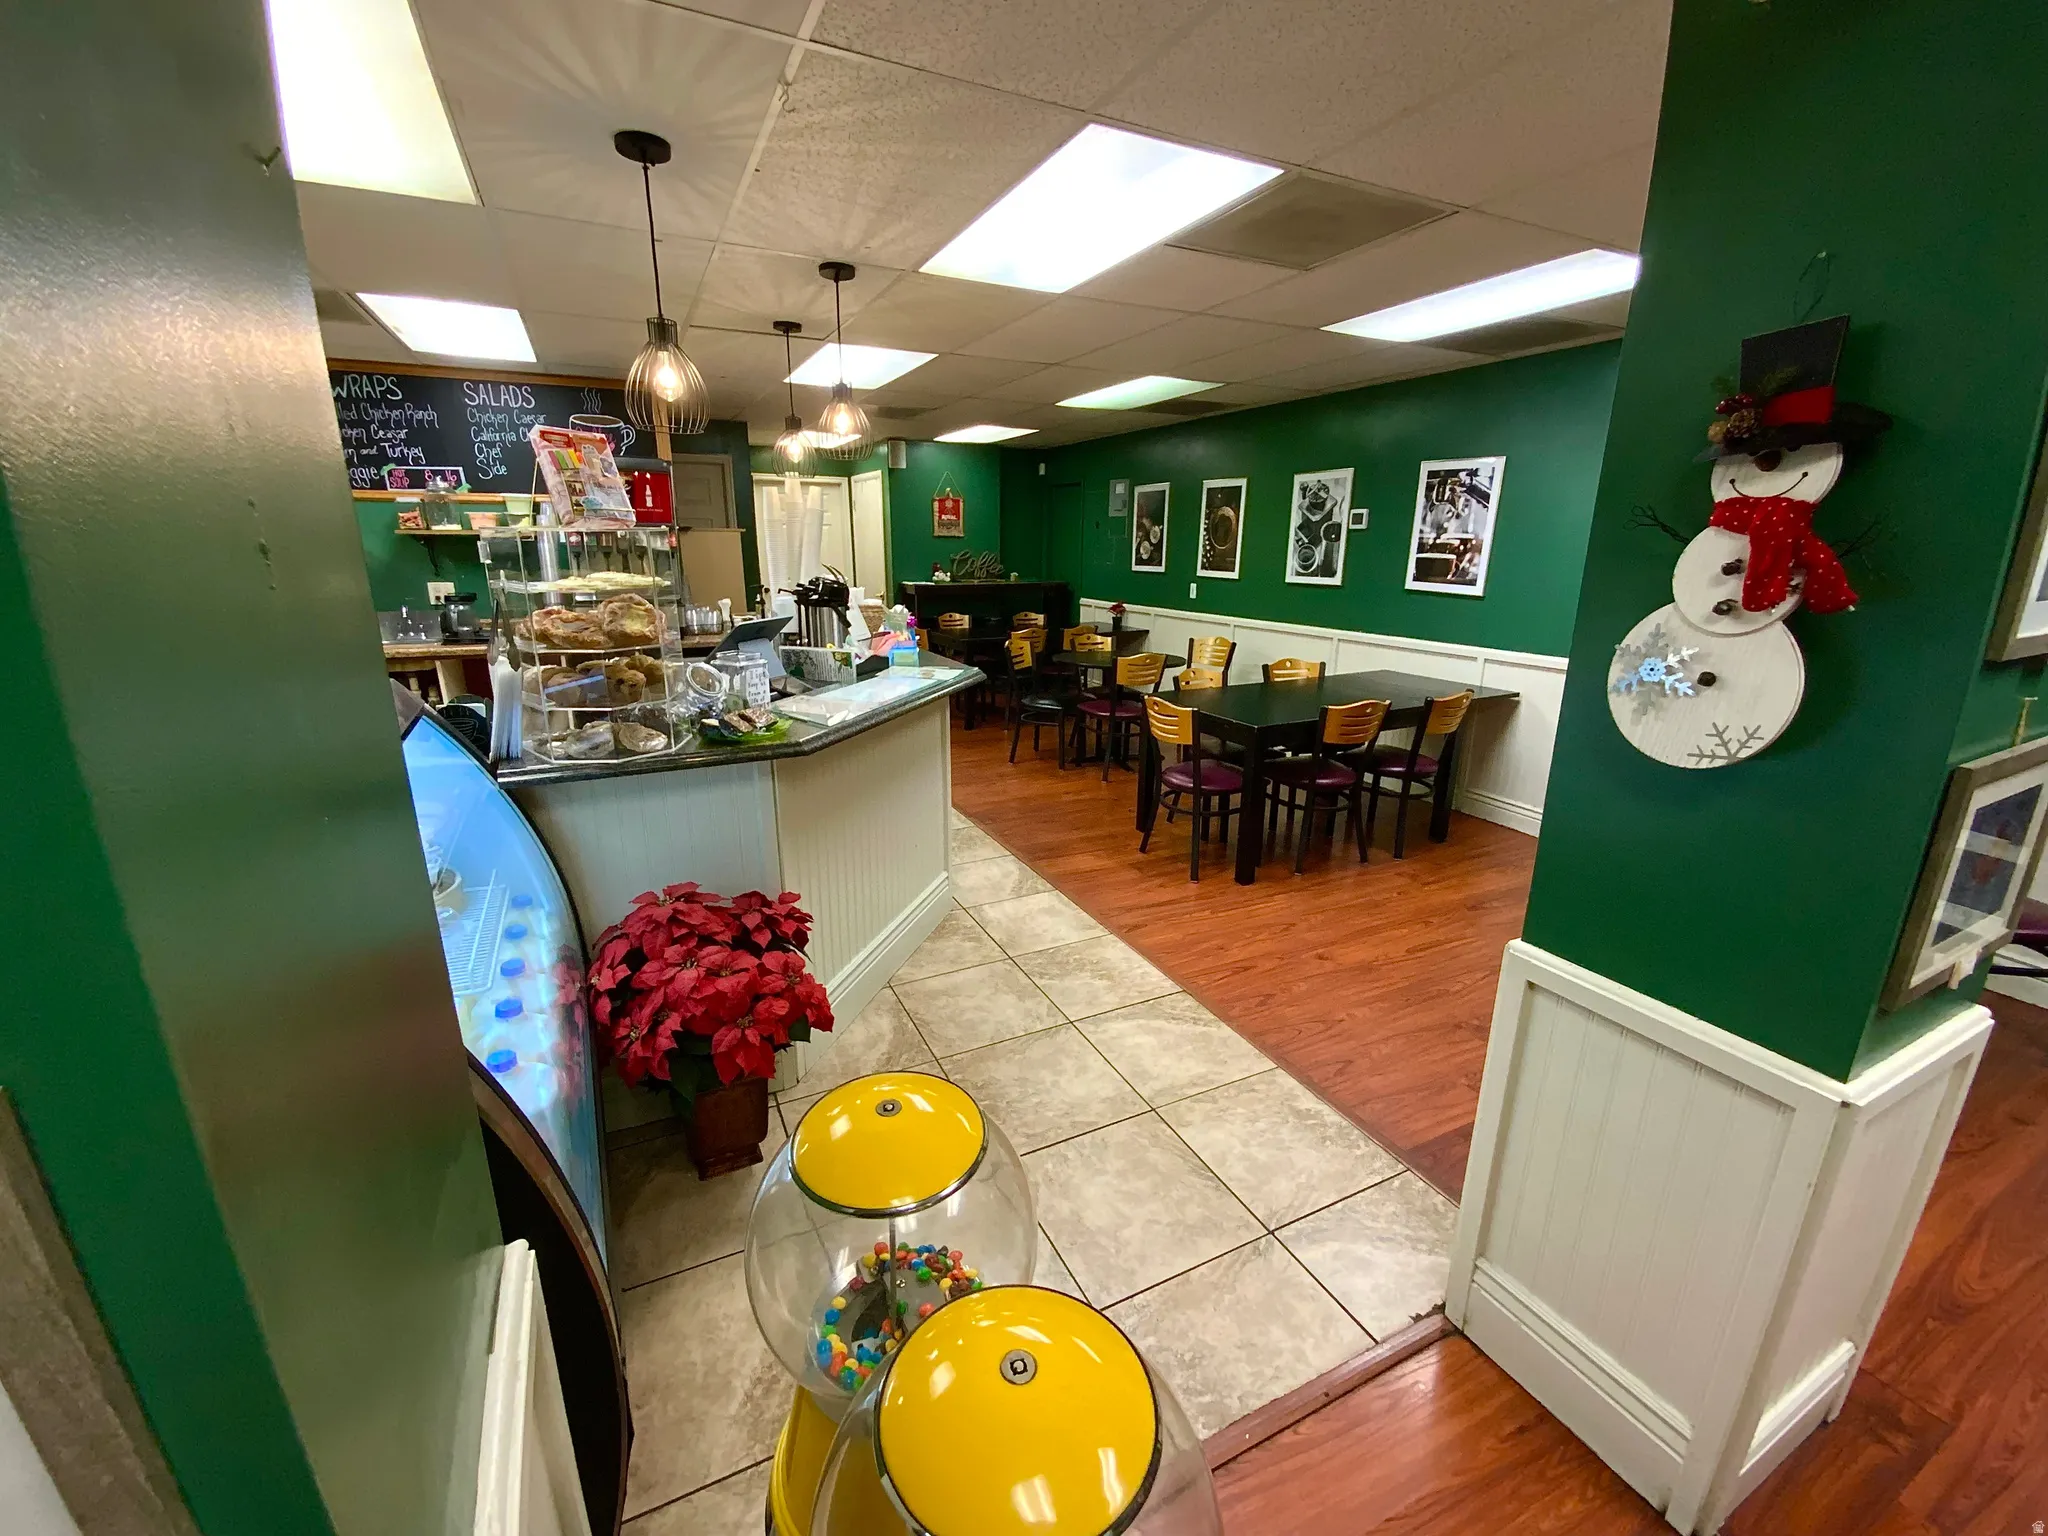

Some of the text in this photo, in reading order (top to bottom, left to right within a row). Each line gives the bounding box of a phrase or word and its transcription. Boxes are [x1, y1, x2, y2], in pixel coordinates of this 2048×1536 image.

[333, 374, 402, 400] WRAPS
[463, 382, 536, 409] SALADS
[361, 402, 406, 428] Chicken
[405, 402, 439, 428] Ranch
[467, 407, 547, 430] Chicken Caesar
[370, 424, 408, 444] Ceasar
[471, 426, 517, 448] California
[360, 442, 426, 465] and Turkey
[475, 443, 503, 464] Chef
[349, 465, 380, 488] ggie
[391, 469, 406, 477] HOT
[476, 458, 508, 480] Side
[390, 476, 410, 488] SOUP
[950, 549, 1005, 579] Coffee
